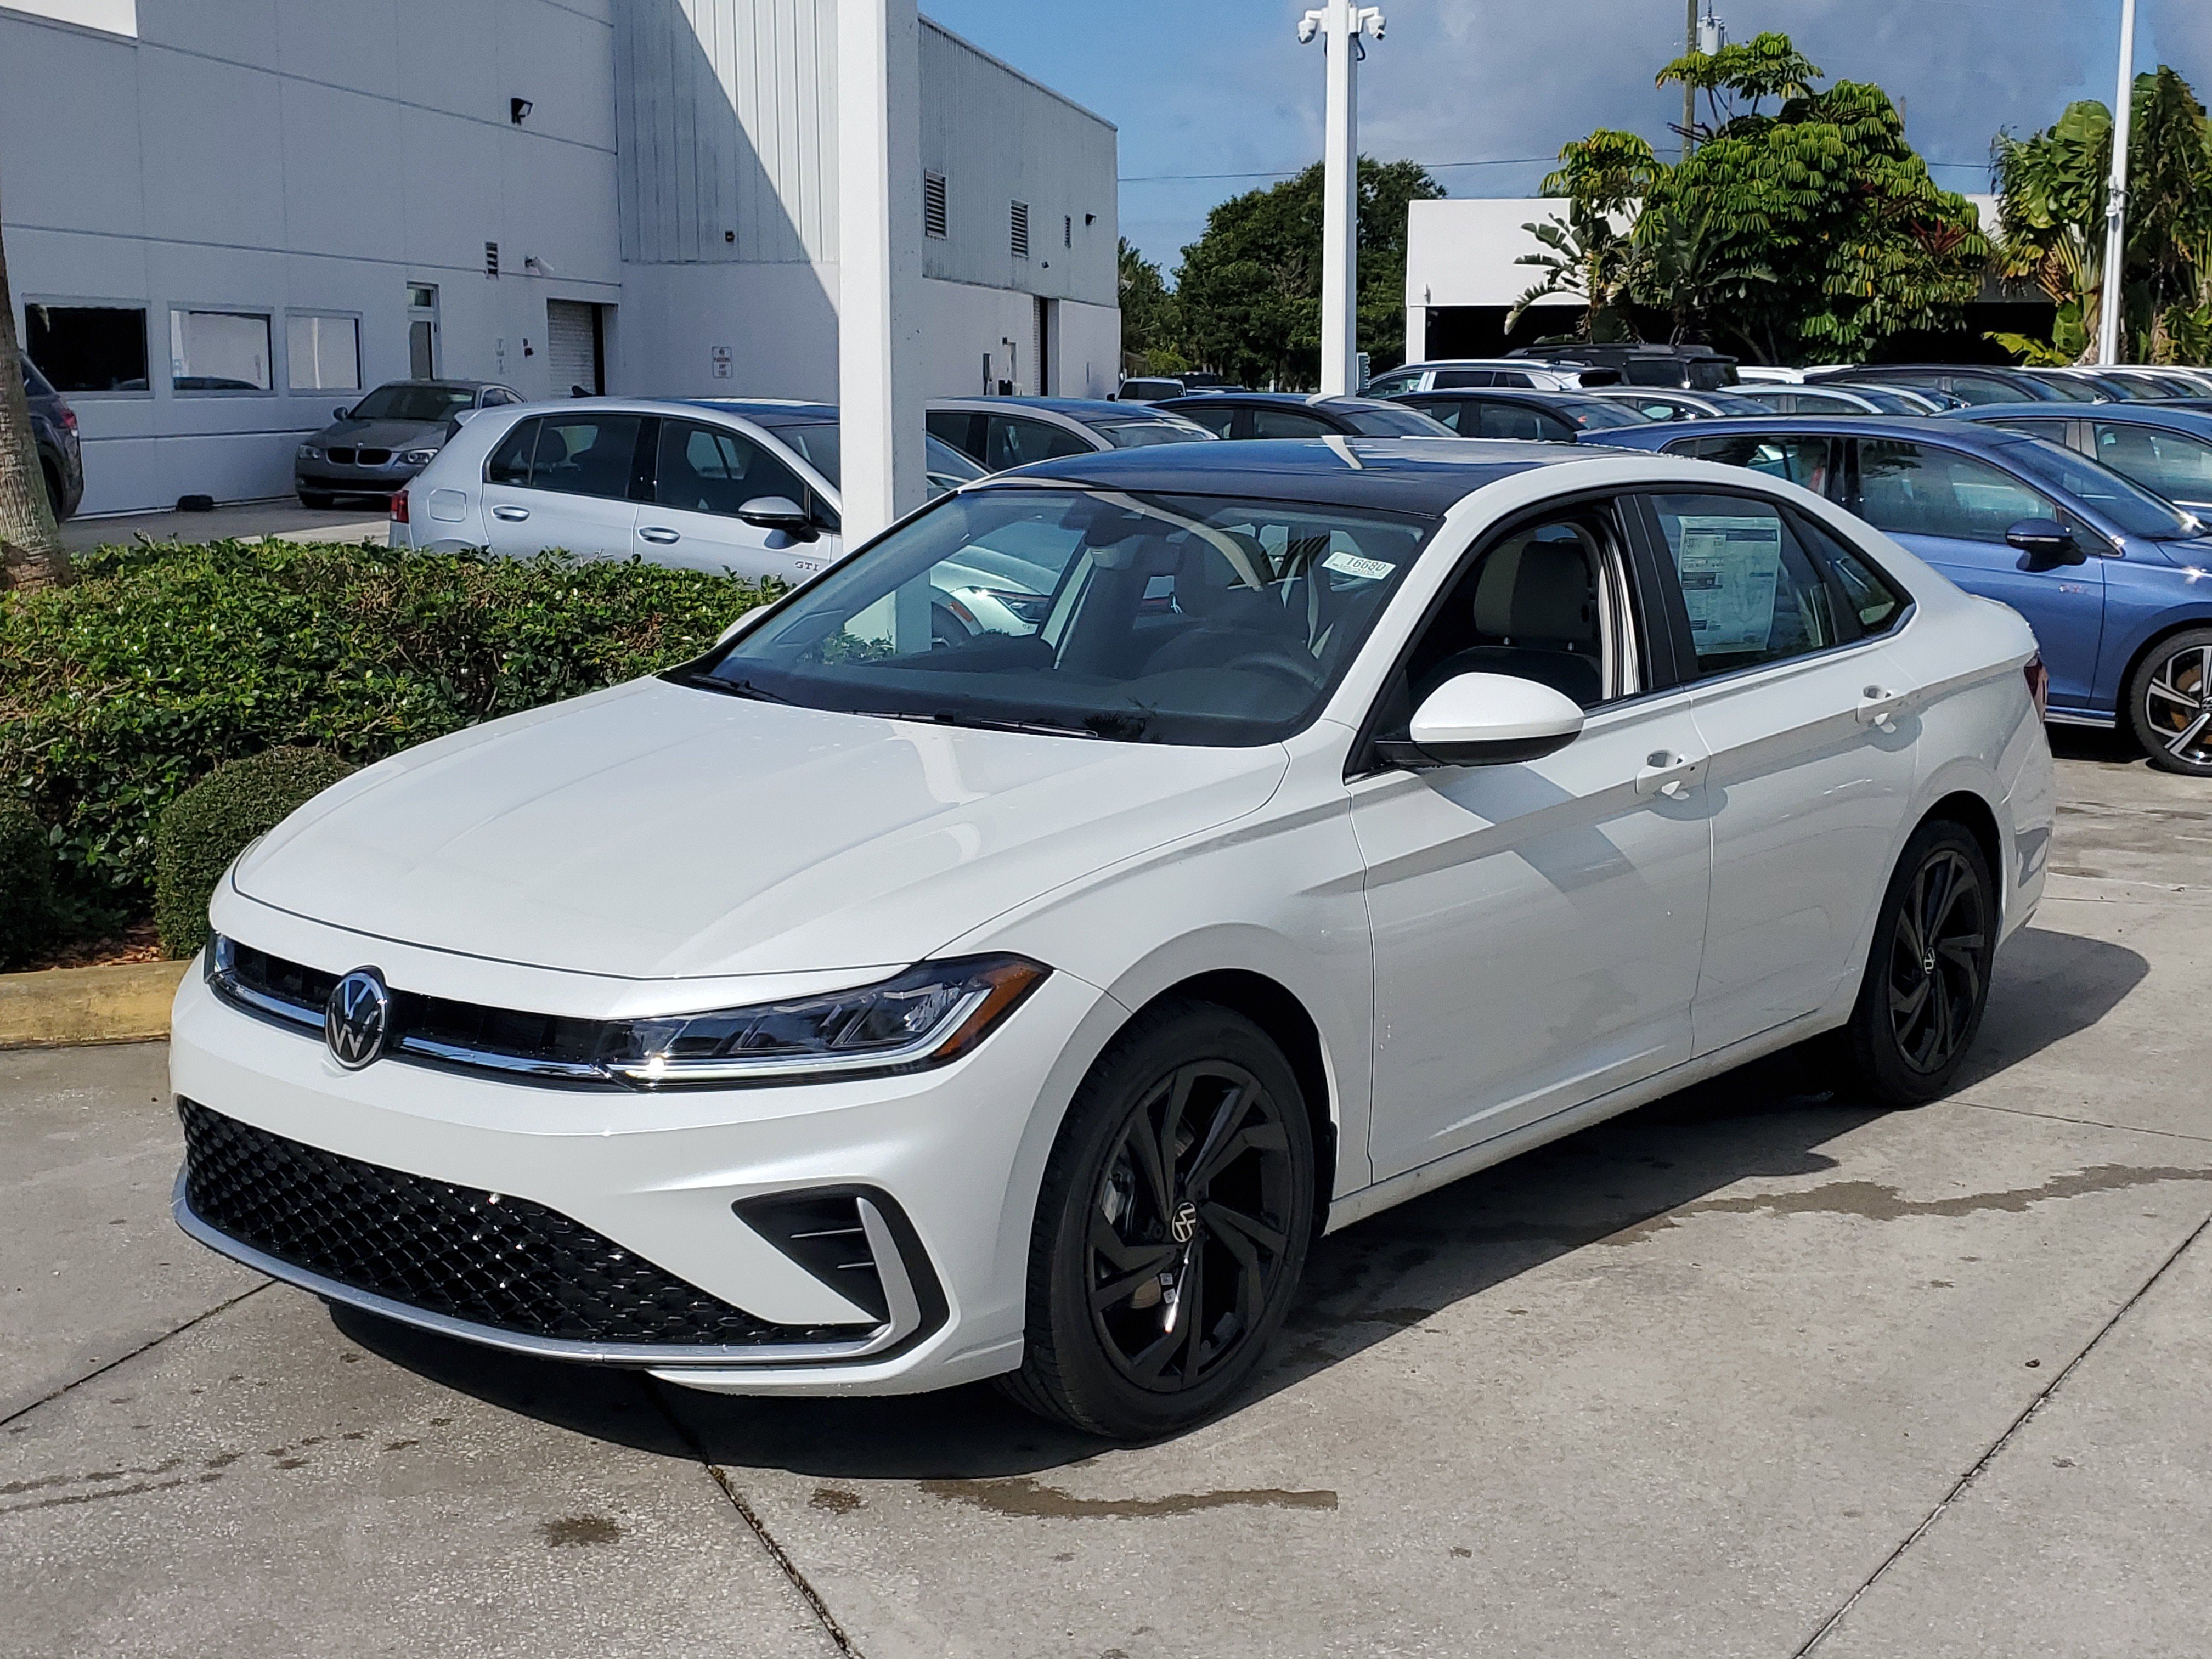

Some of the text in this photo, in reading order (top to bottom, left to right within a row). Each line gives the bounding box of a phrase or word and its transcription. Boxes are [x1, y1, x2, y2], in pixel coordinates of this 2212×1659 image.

[795, 561, 819, 571] GTI
[1346, 557, 1386, 572] 16680
[328, 973, 385, 1063] VW
